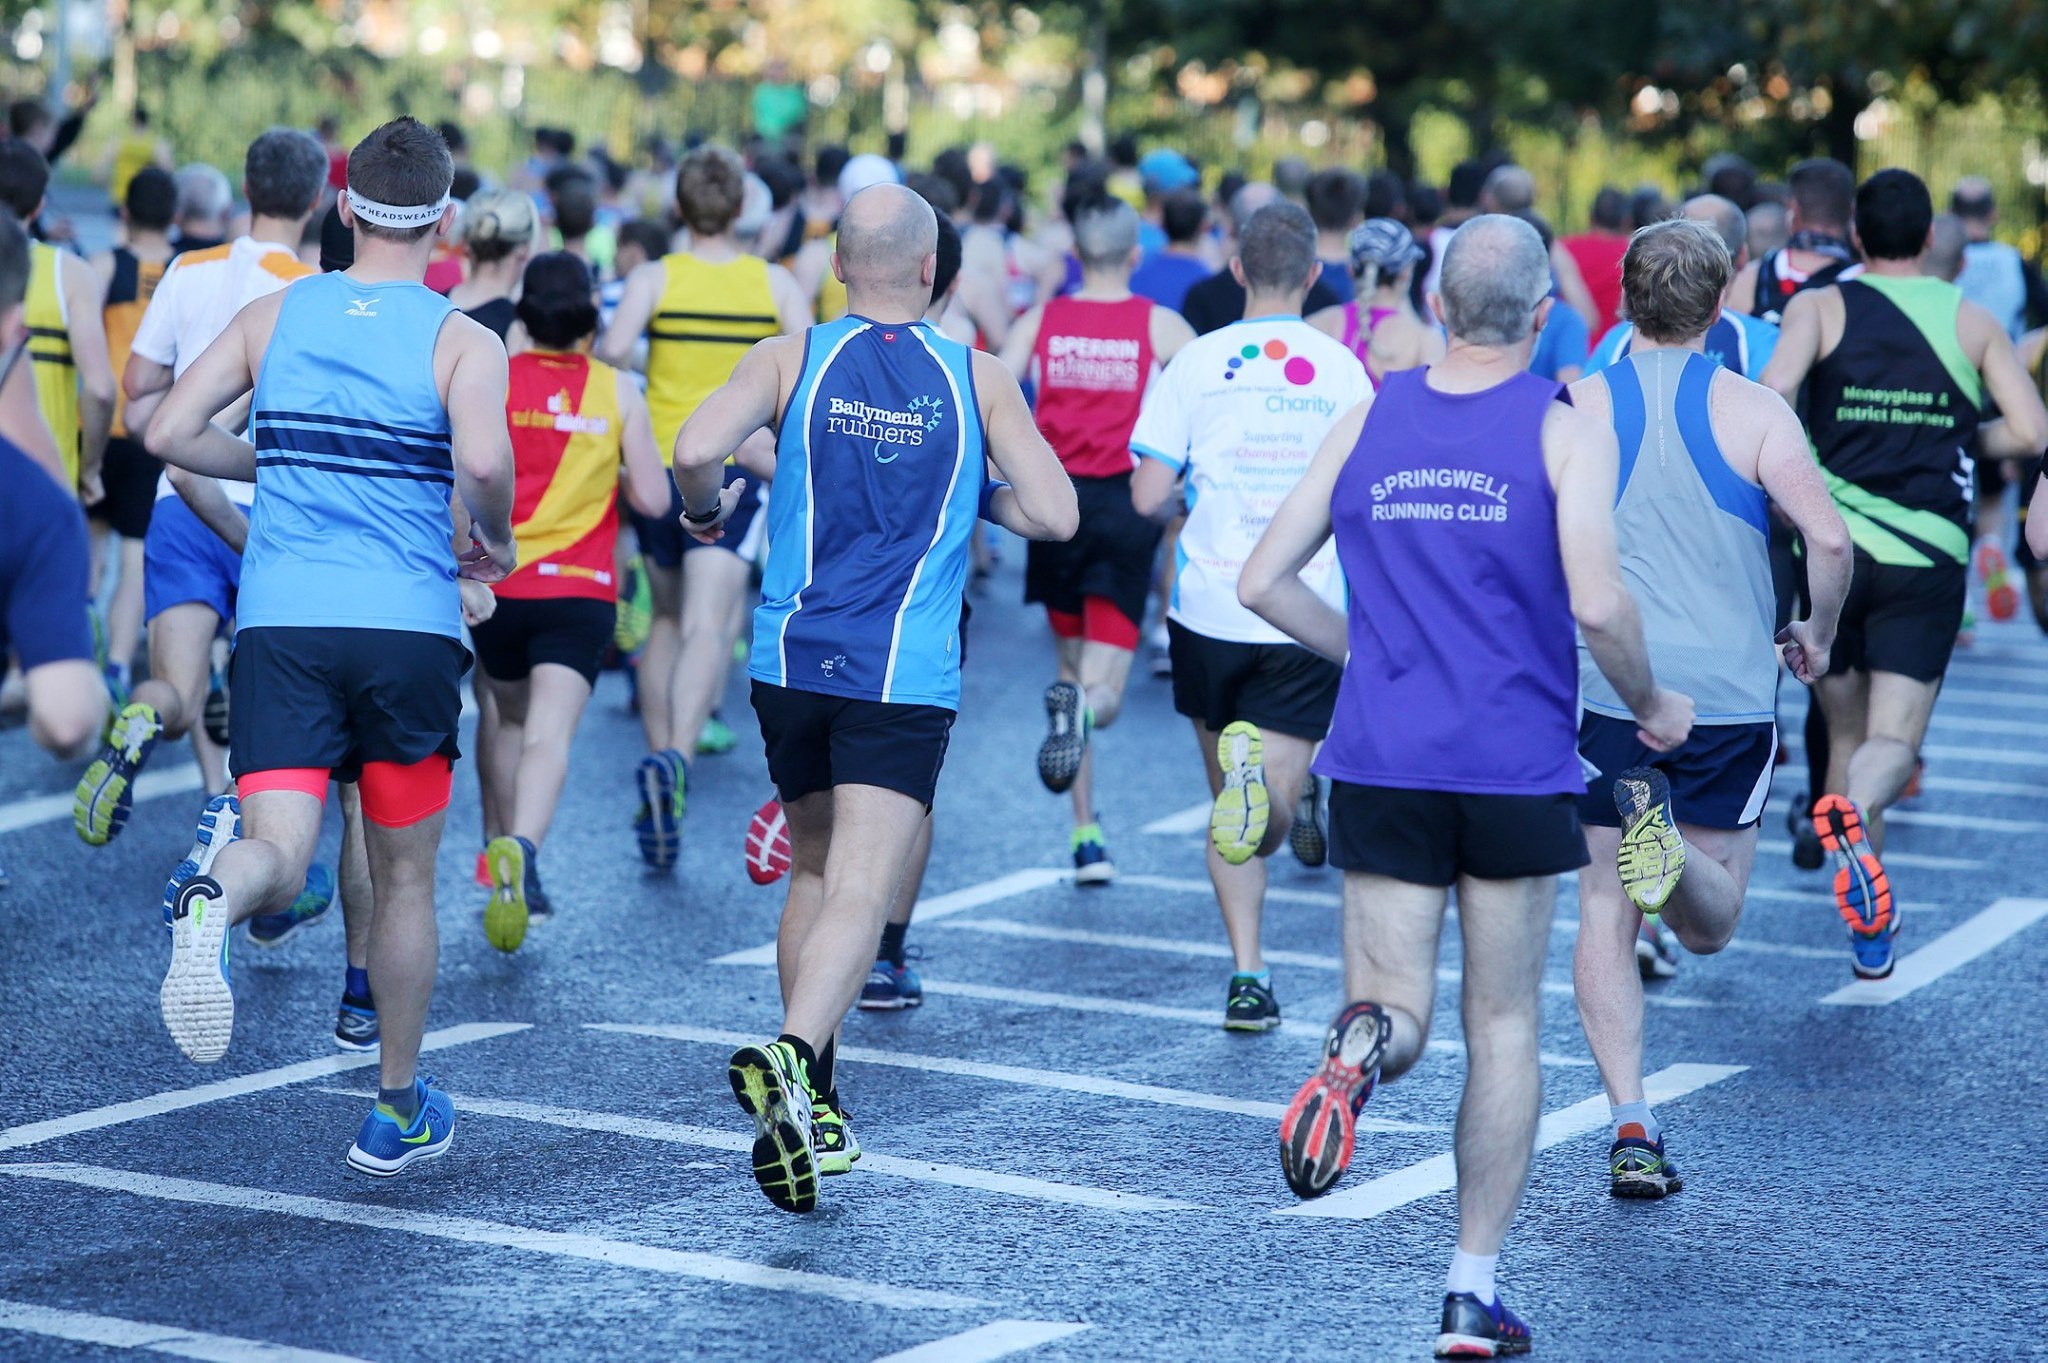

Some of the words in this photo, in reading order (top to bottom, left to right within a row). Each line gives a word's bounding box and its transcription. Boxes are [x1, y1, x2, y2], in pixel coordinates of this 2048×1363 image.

[368, 207, 438, 221] HEADSWEATS
[1047, 335, 1140, 359] SPERRIN
[1265, 394, 1337, 417] Charity
[1842, 385, 1934, 406] Moneyglass
[828, 397, 924, 426] Ballymena
[826, 416, 924, 446] runners
[1244, 430, 1303, 444] Supporting
[1233, 463, 1308, 476] Hammersmit
[1370, 468, 1510, 505] SPRINGWELL
[1371, 502, 1455, 521] RUNNING
[1457, 503, 1508, 523] CLUB
